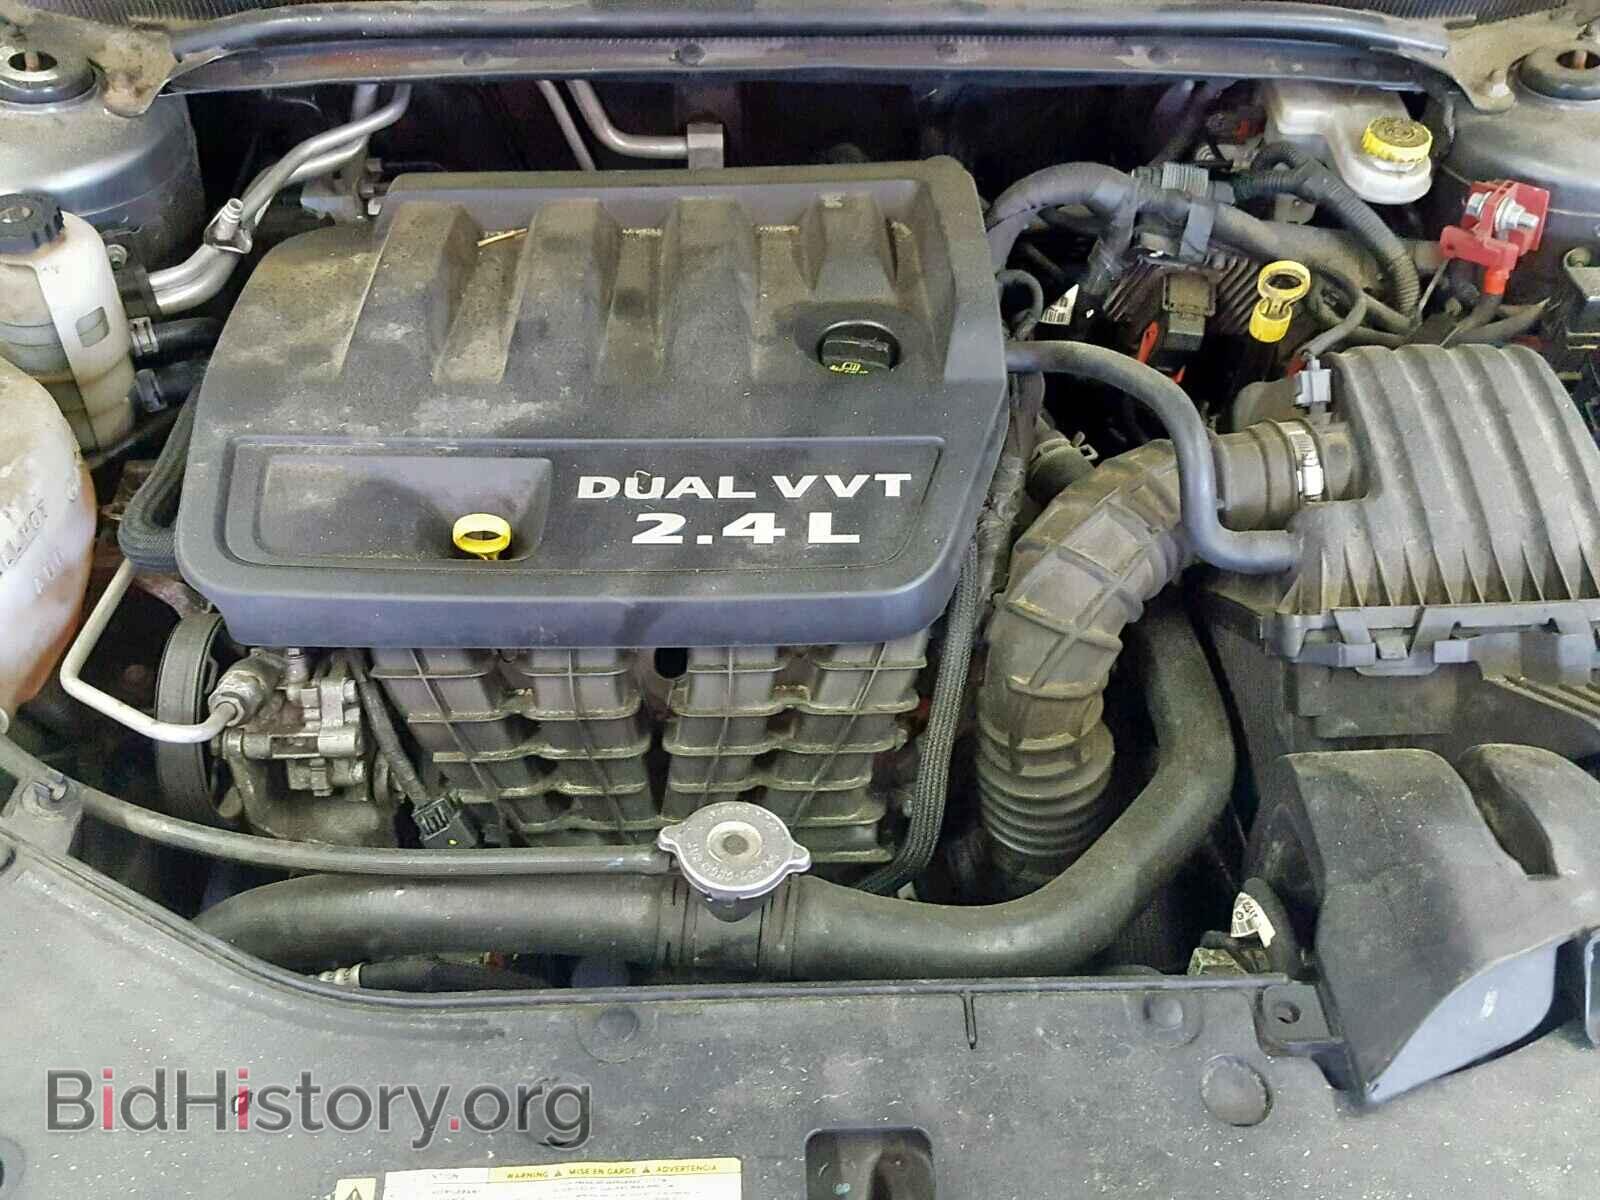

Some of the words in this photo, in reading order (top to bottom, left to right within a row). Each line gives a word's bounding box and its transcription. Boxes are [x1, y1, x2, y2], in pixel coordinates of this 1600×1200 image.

[576, 475, 756, 499] DUAL
[771, 473, 912, 498] VVT
[631, 512, 786, 545] 2.4
[807, 511, 860, 544] L
[607, 1167, 636, 1175] GARDE
[656, 1165, 717, 1173] ADVERTENCIA
